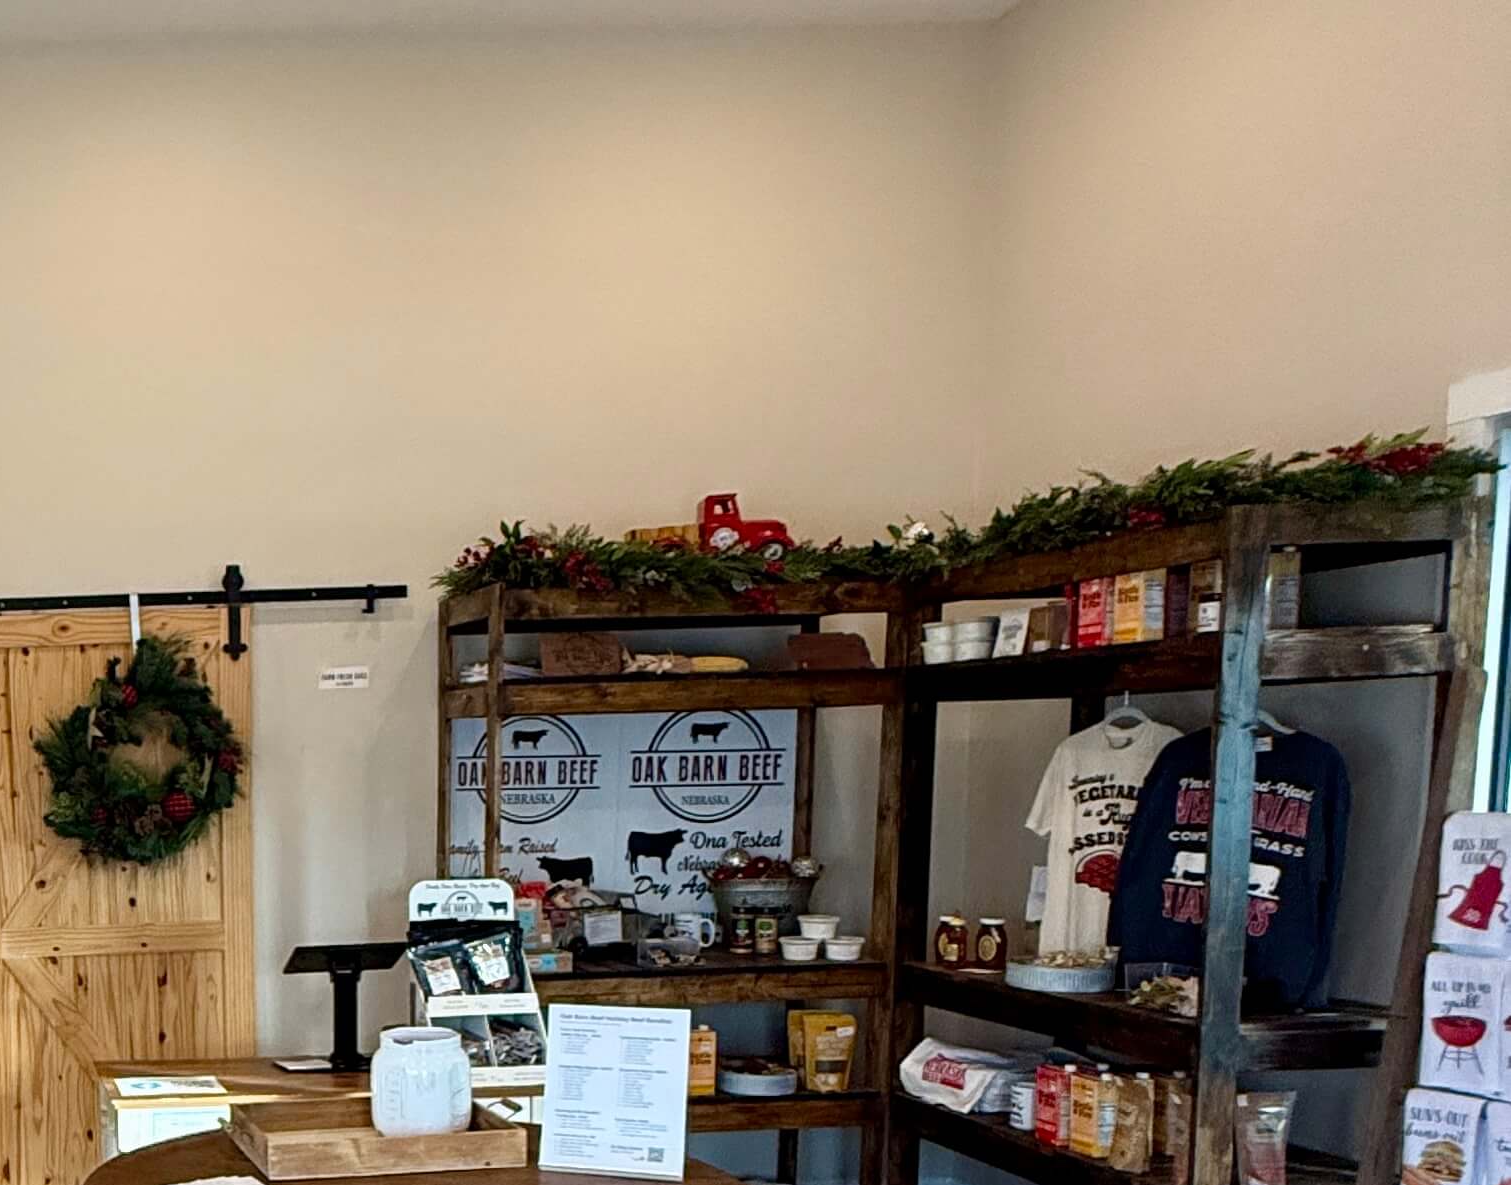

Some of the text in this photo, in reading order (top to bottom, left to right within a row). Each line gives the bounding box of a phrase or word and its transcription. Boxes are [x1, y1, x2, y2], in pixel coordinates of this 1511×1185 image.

[501, 761, 547, 784] BARN
[558, 760, 598, 784] BEEF
[632, 754, 783, 783] OAK BARN BEEF
[681, 795, 730, 805] NEBRASKA
[1073, 784, 1138, 808] EGETAR
[450, 839, 480, 859] amily
[689, 829, 784, 850] Dna Tested
[1068, 832, 1116, 856] SSED
[677, 856, 721, 873] Nebras
[634, 875, 714, 900] Dry Ag
